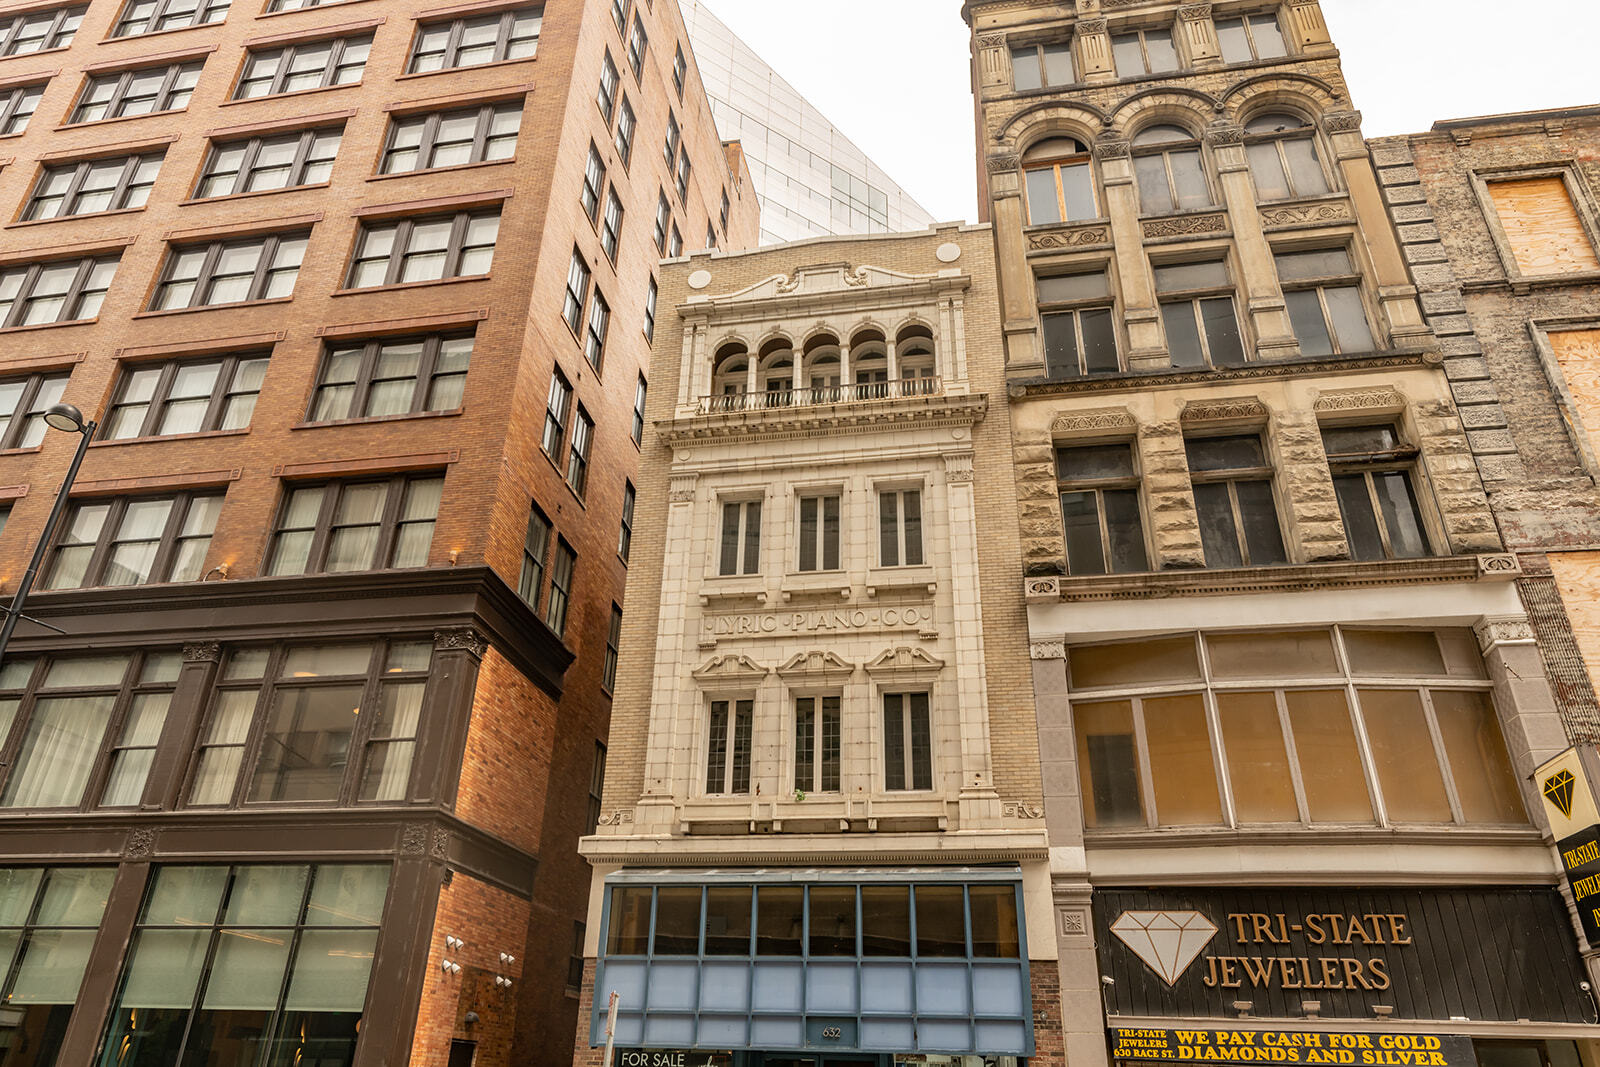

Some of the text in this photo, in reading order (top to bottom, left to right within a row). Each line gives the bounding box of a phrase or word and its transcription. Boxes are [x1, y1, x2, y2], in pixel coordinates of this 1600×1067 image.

[714, 615, 777, 635] LYRIC
[791, 609, 868, 632] PIANO
[1563, 839, 1600, 870] TRI-STATE
[1228, 913, 1412, 945] TRI-STATE
[1203, 955, 1390, 991] JEWELERS
[822, 1026, 841, 1038] 632
[1117, 1028, 1167, 1038] TRI-STATE
[1174, 1030, 1441, 1050] WE PAY CASH FOR GOLD
[1113, 1048, 1176, 1058] 630 RACE ST.
[1118, 1038, 1168, 1049] JEWELERS
[621, 1052, 649, 1067] FOR
[652, 1052, 685, 1067] SALE
[1177, 1045, 1448, 1066] DIAMONDS AND SILVER
